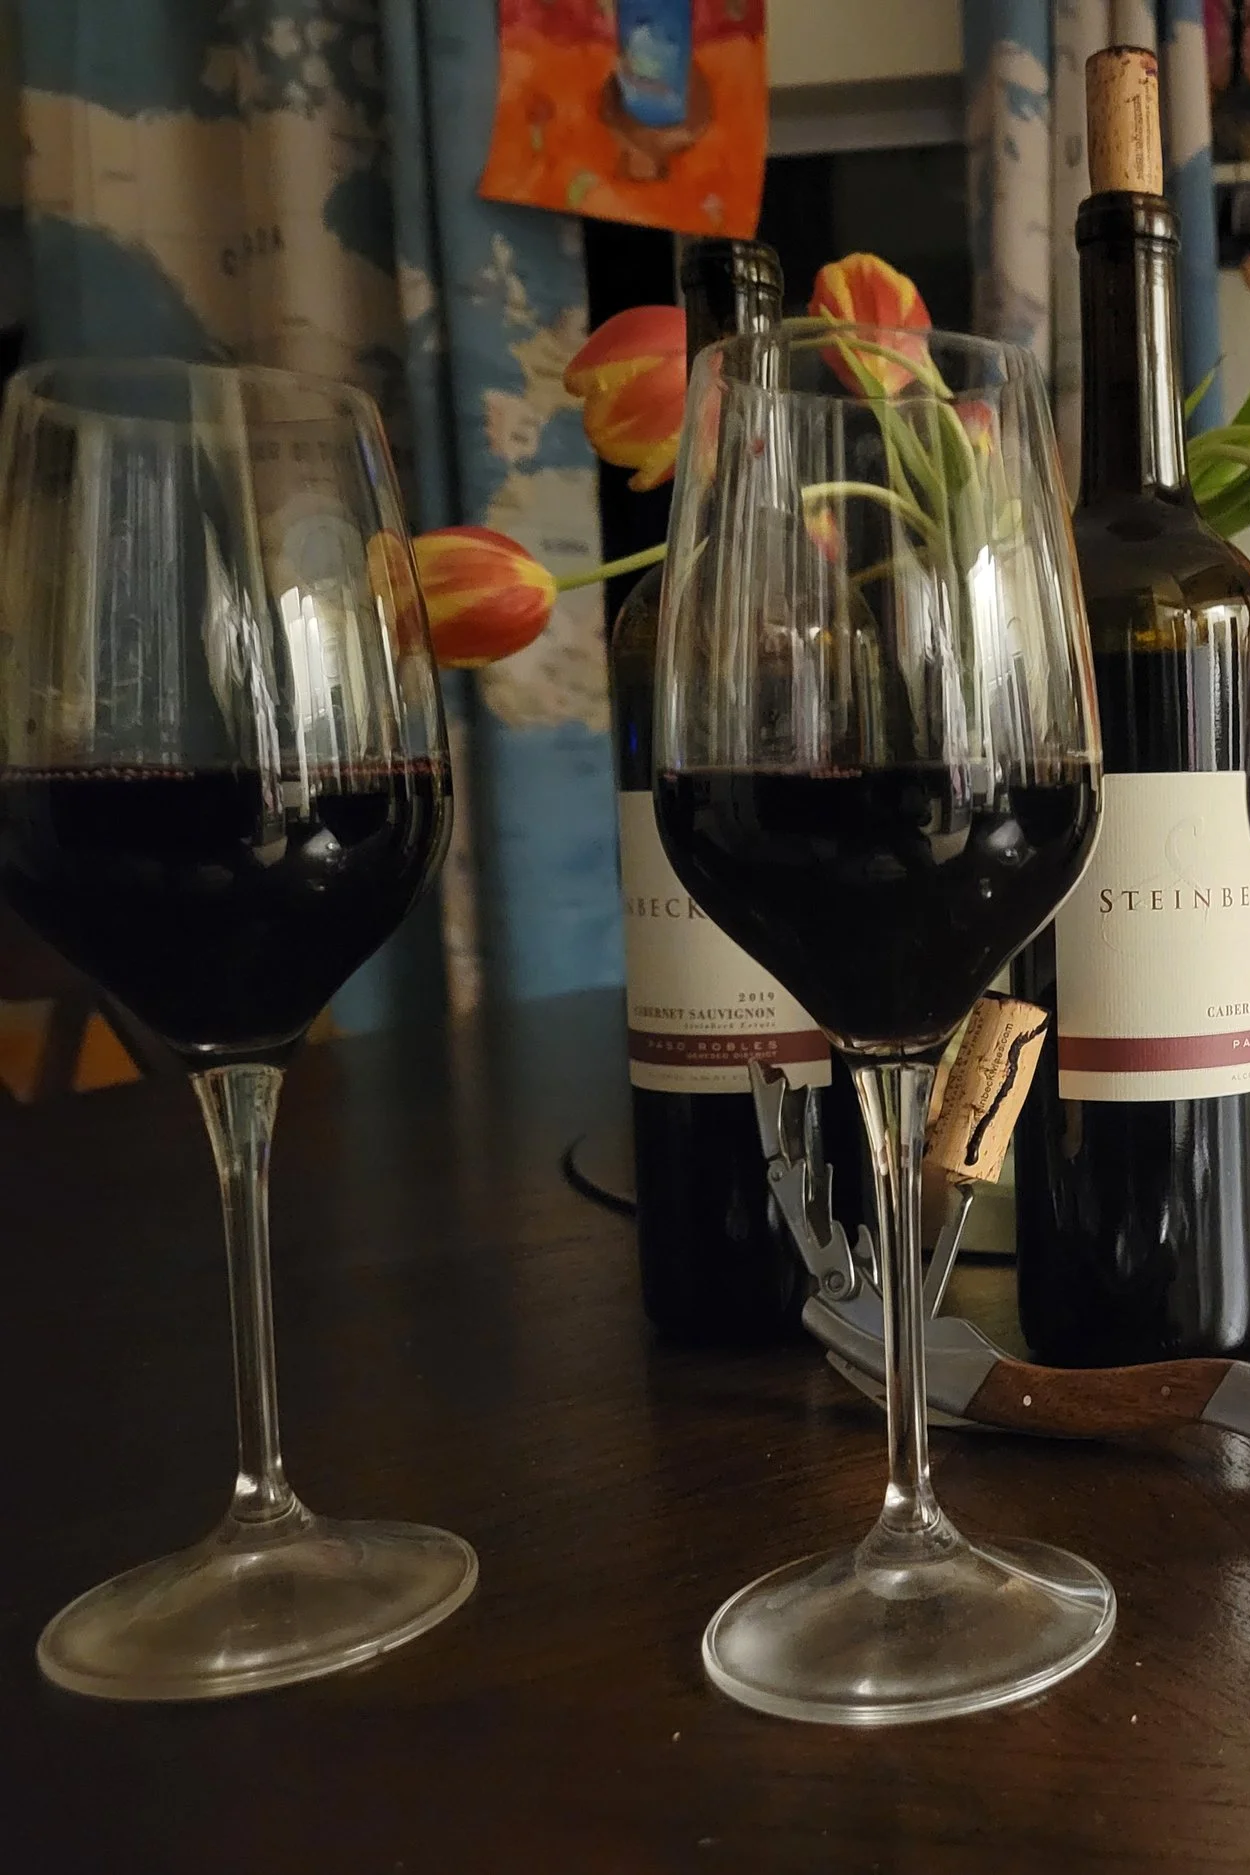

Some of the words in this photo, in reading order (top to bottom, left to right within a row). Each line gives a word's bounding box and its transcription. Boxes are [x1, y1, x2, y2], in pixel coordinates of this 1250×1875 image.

[738, 992, 776, 1003] 2019
[688, 1007, 776, 1021] SAUVIGNON
[698, 1040, 779, 1052] ROBLES
